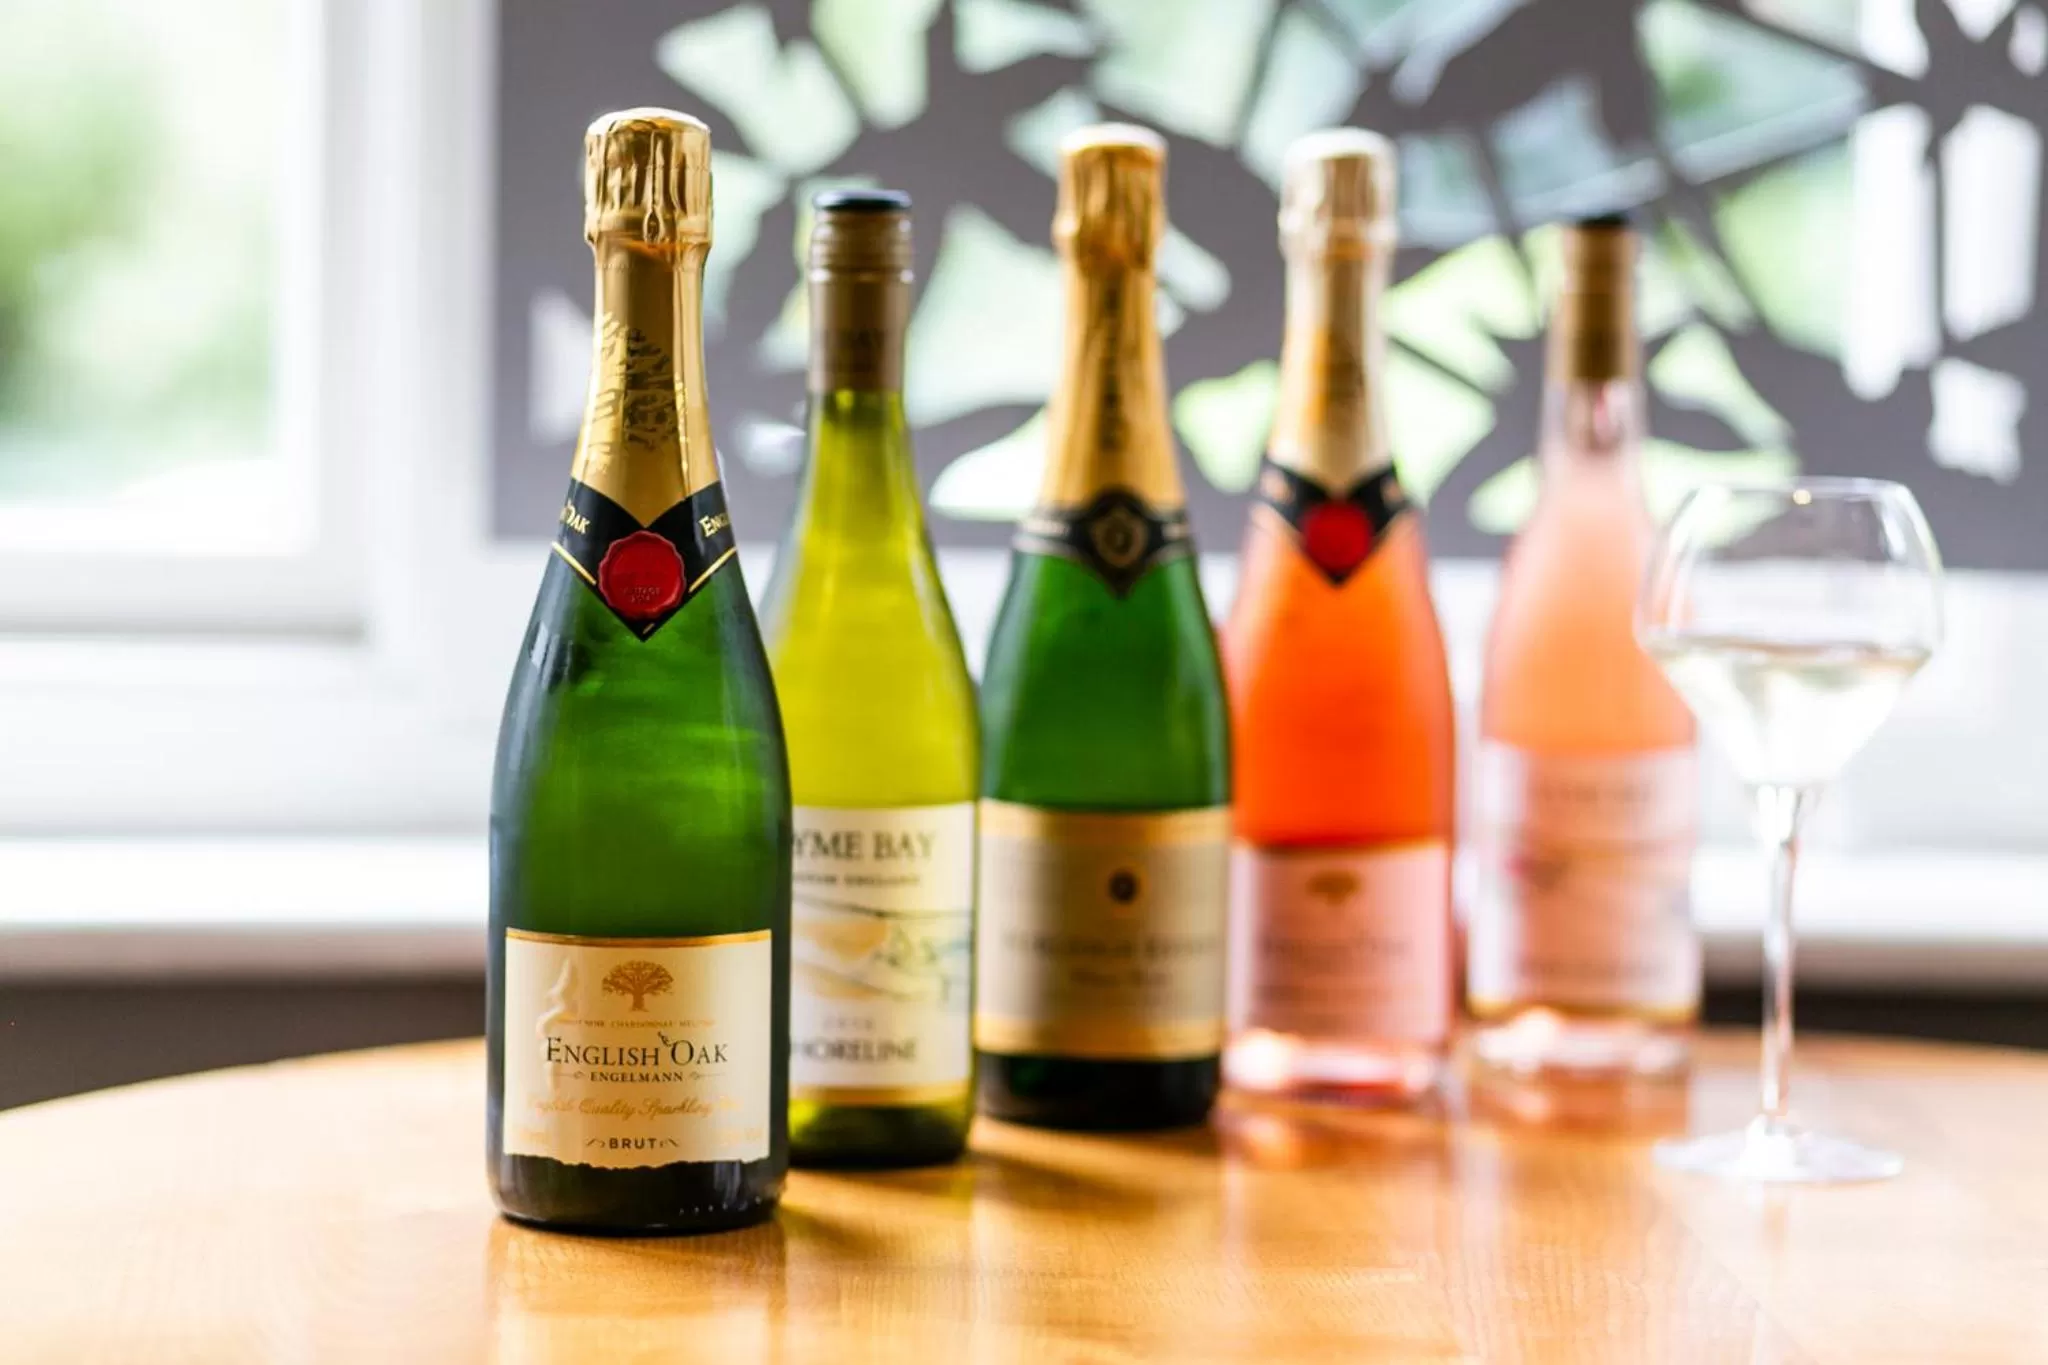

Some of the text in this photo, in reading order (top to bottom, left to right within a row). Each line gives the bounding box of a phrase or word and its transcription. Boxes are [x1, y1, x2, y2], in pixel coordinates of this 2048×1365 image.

[871, 828, 938, 862] BAY
[546, 1036, 729, 1067] ENGLISH OAK
[590, 1071, 684, 1084] ENGELMANN
[578, 1098, 636, 1121] Quality
[637, 1097, 714, 1121] Sparkling
[608, 1137, 657, 1150] BRUT
